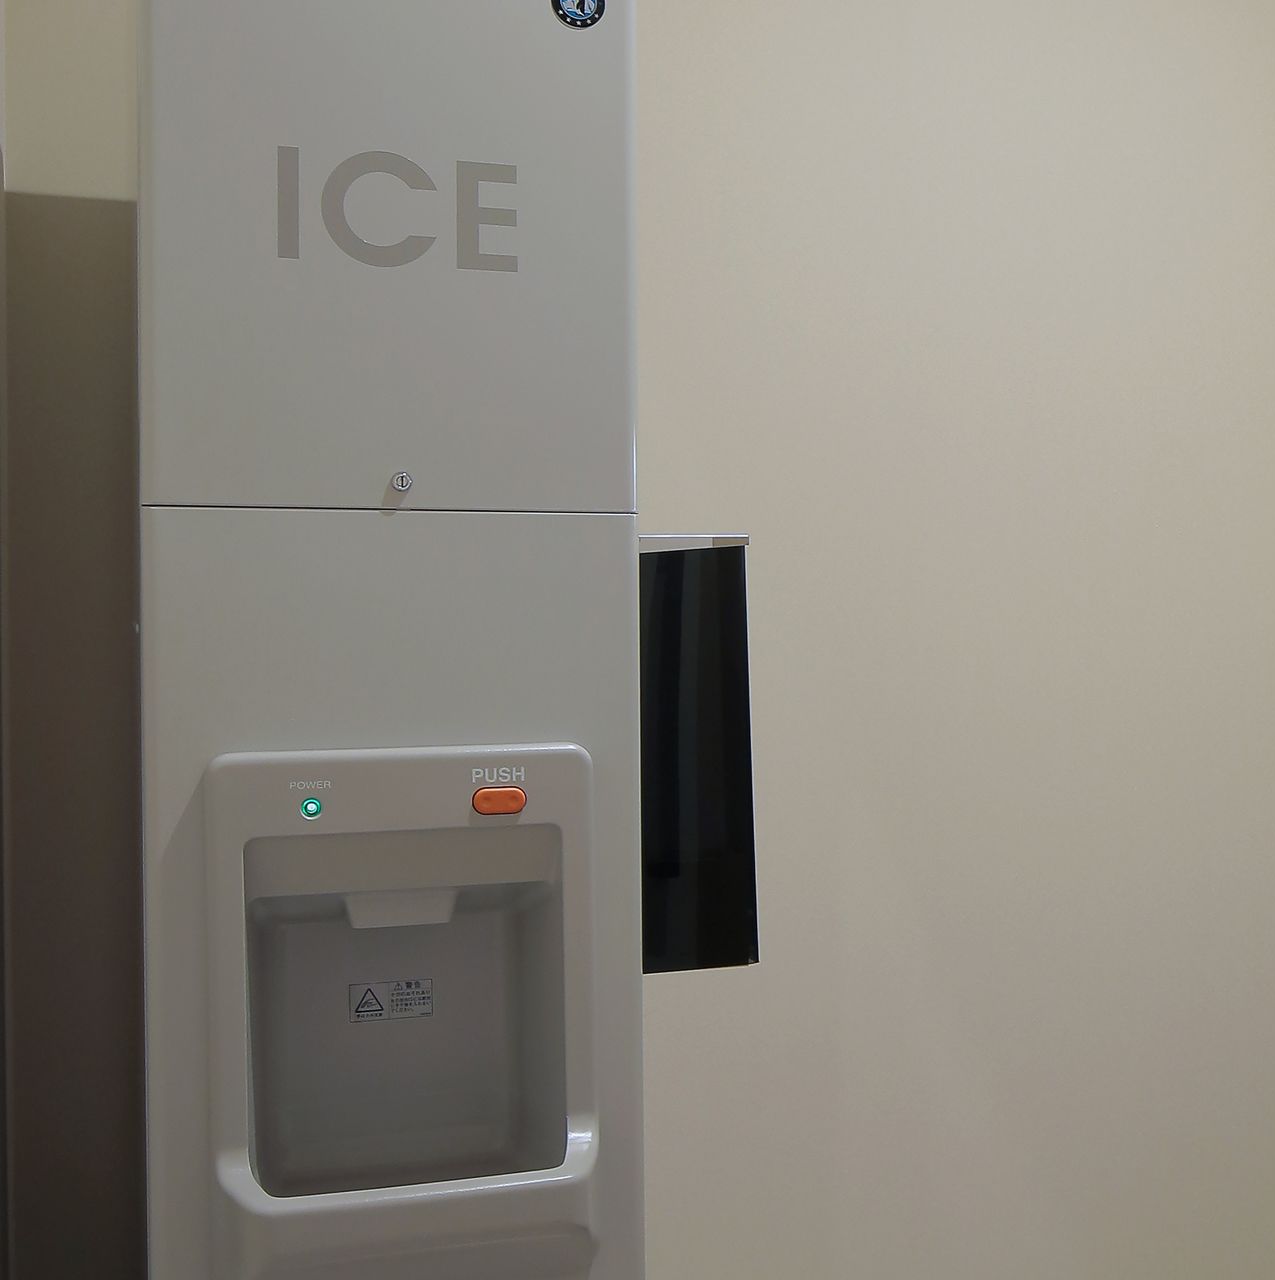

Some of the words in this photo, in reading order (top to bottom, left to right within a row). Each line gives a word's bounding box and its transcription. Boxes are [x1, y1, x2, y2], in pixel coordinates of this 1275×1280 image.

[277, 145, 519, 273] ICE
[472, 767, 526, 783] PUSH
[289, 780, 332, 790] POWER
